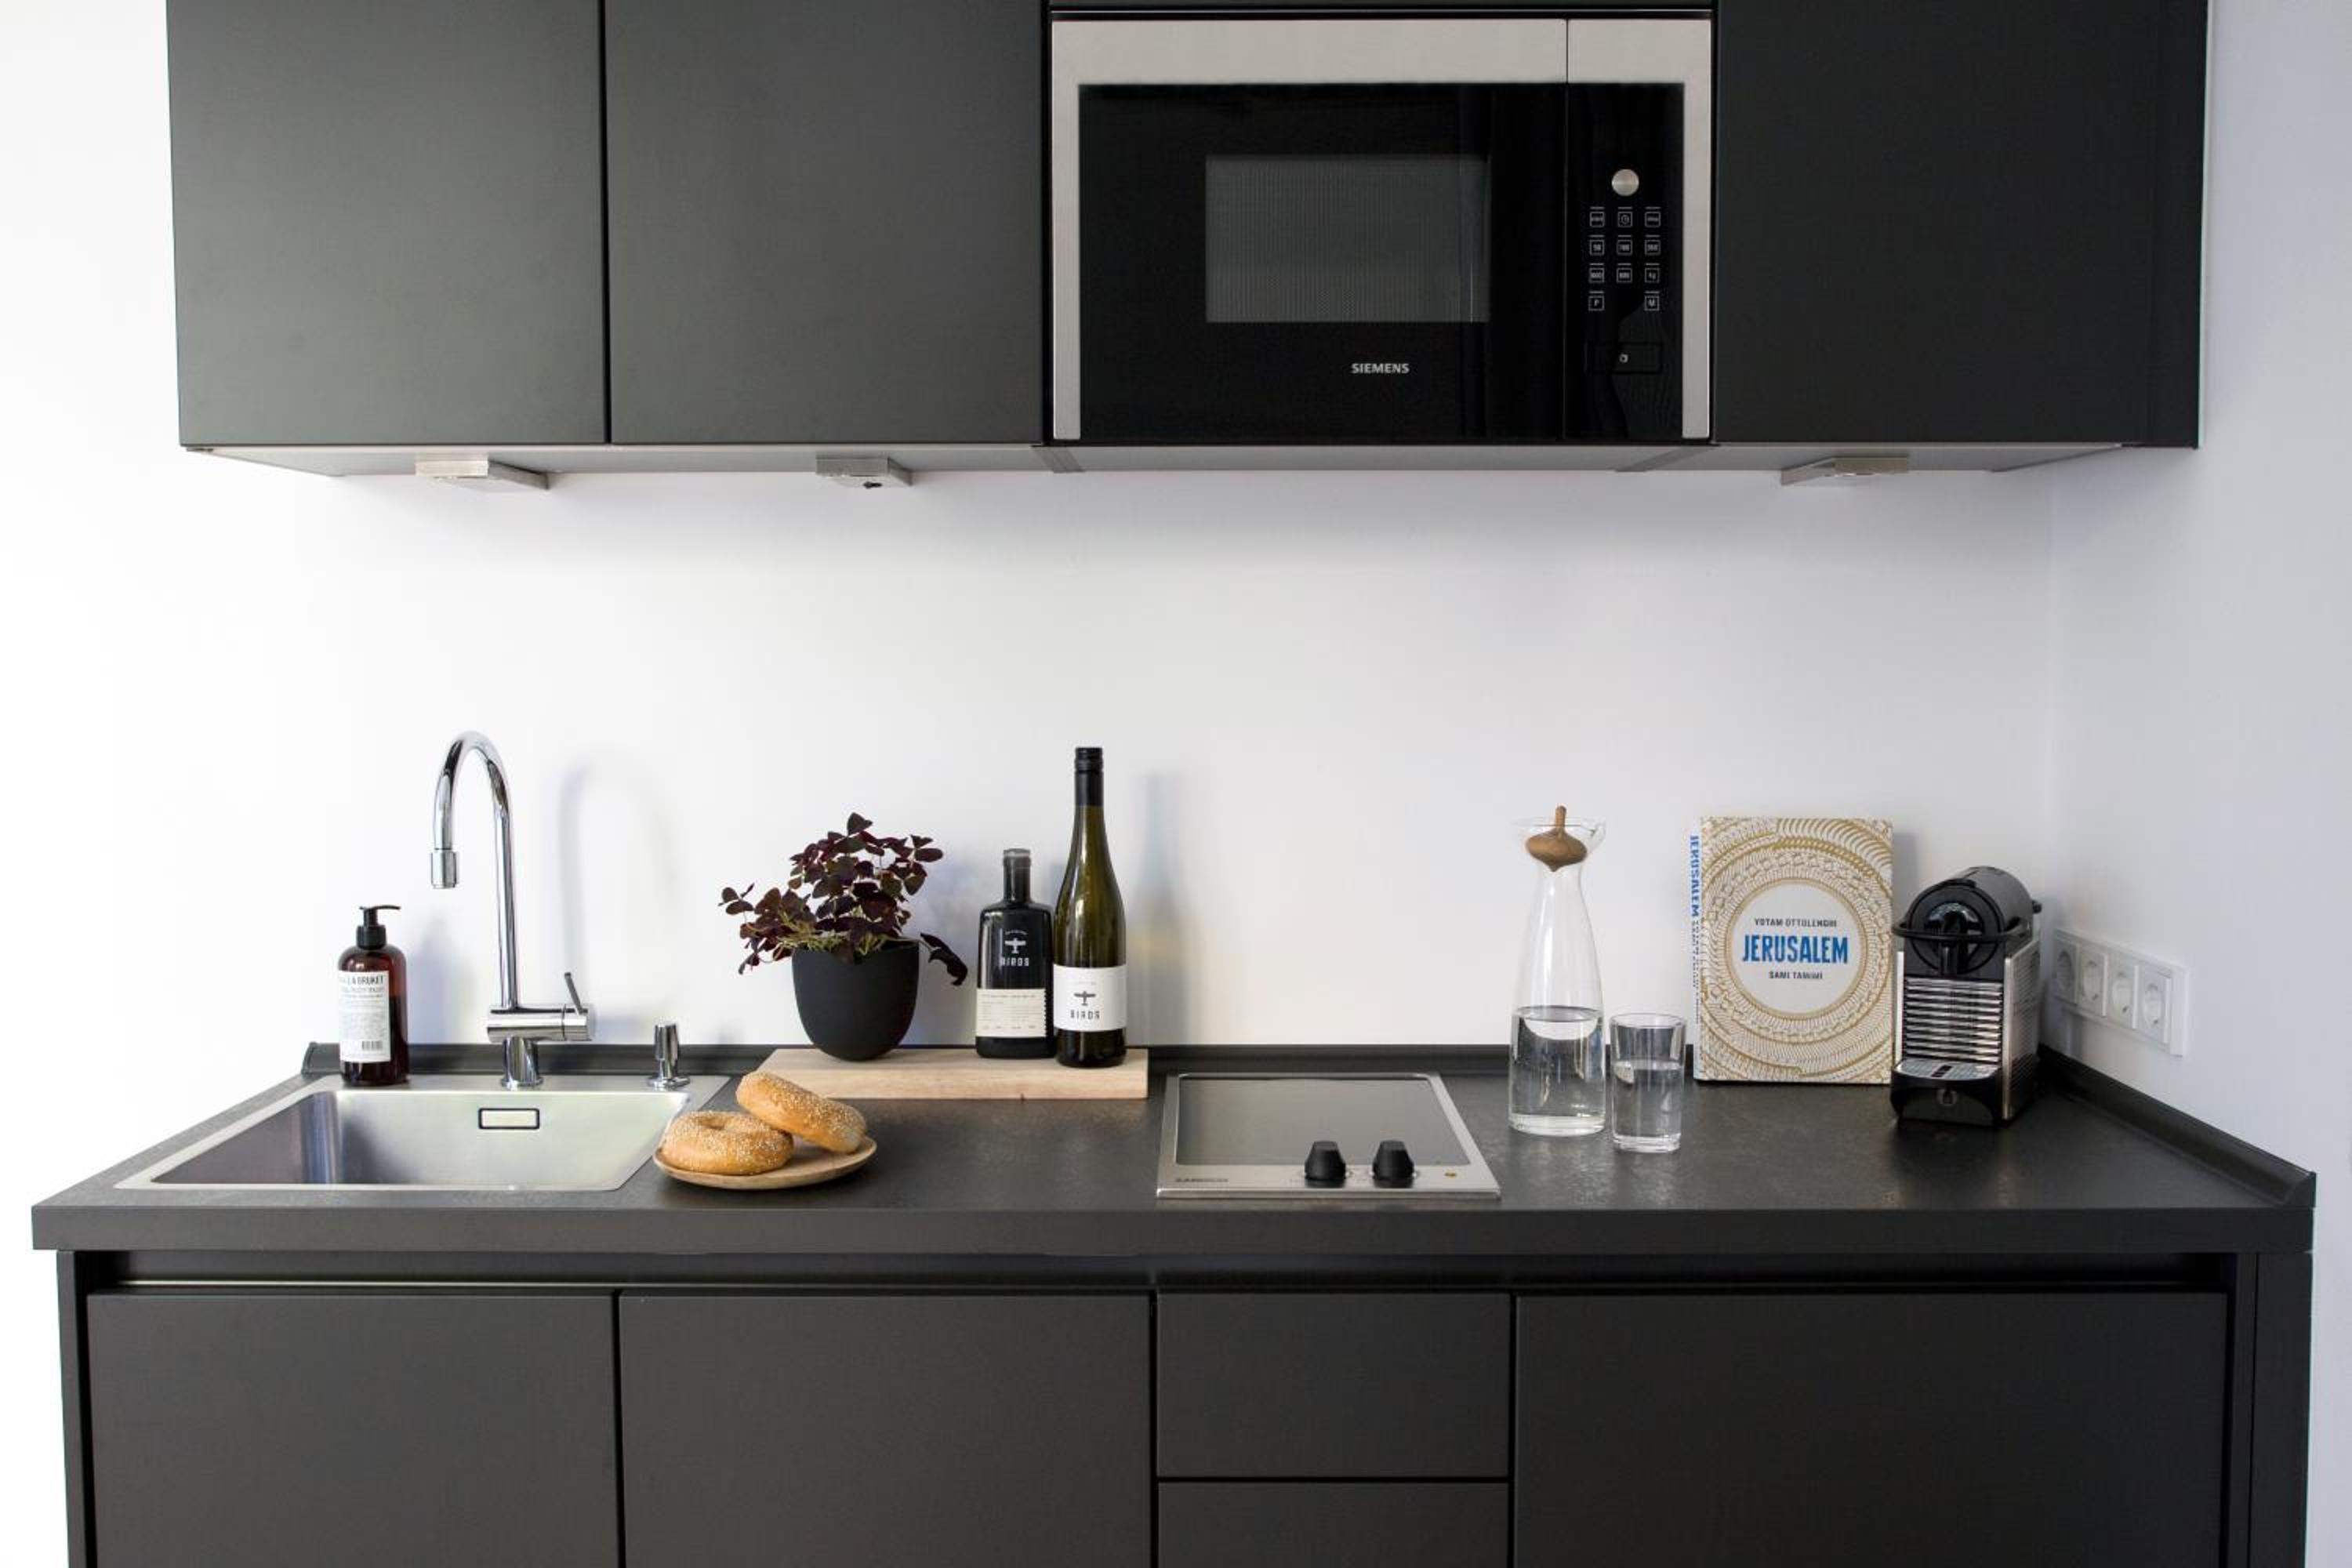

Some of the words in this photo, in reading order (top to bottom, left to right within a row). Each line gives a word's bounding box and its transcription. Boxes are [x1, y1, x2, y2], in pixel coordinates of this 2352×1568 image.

[1351, 362, 1410, 374] SIEMENS
[1690, 834, 1700, 916] JERUSALEM
[1755, 918, 1784, 927] YOTAM
[1785, 919, 1837, 927] OTTOLENGHI
[1742, 935, 1849, 964] JERUSALEM
[1769, 971, 1790, 979] SAMI
[1070, 1010, 1100, 1020] BIRDS
